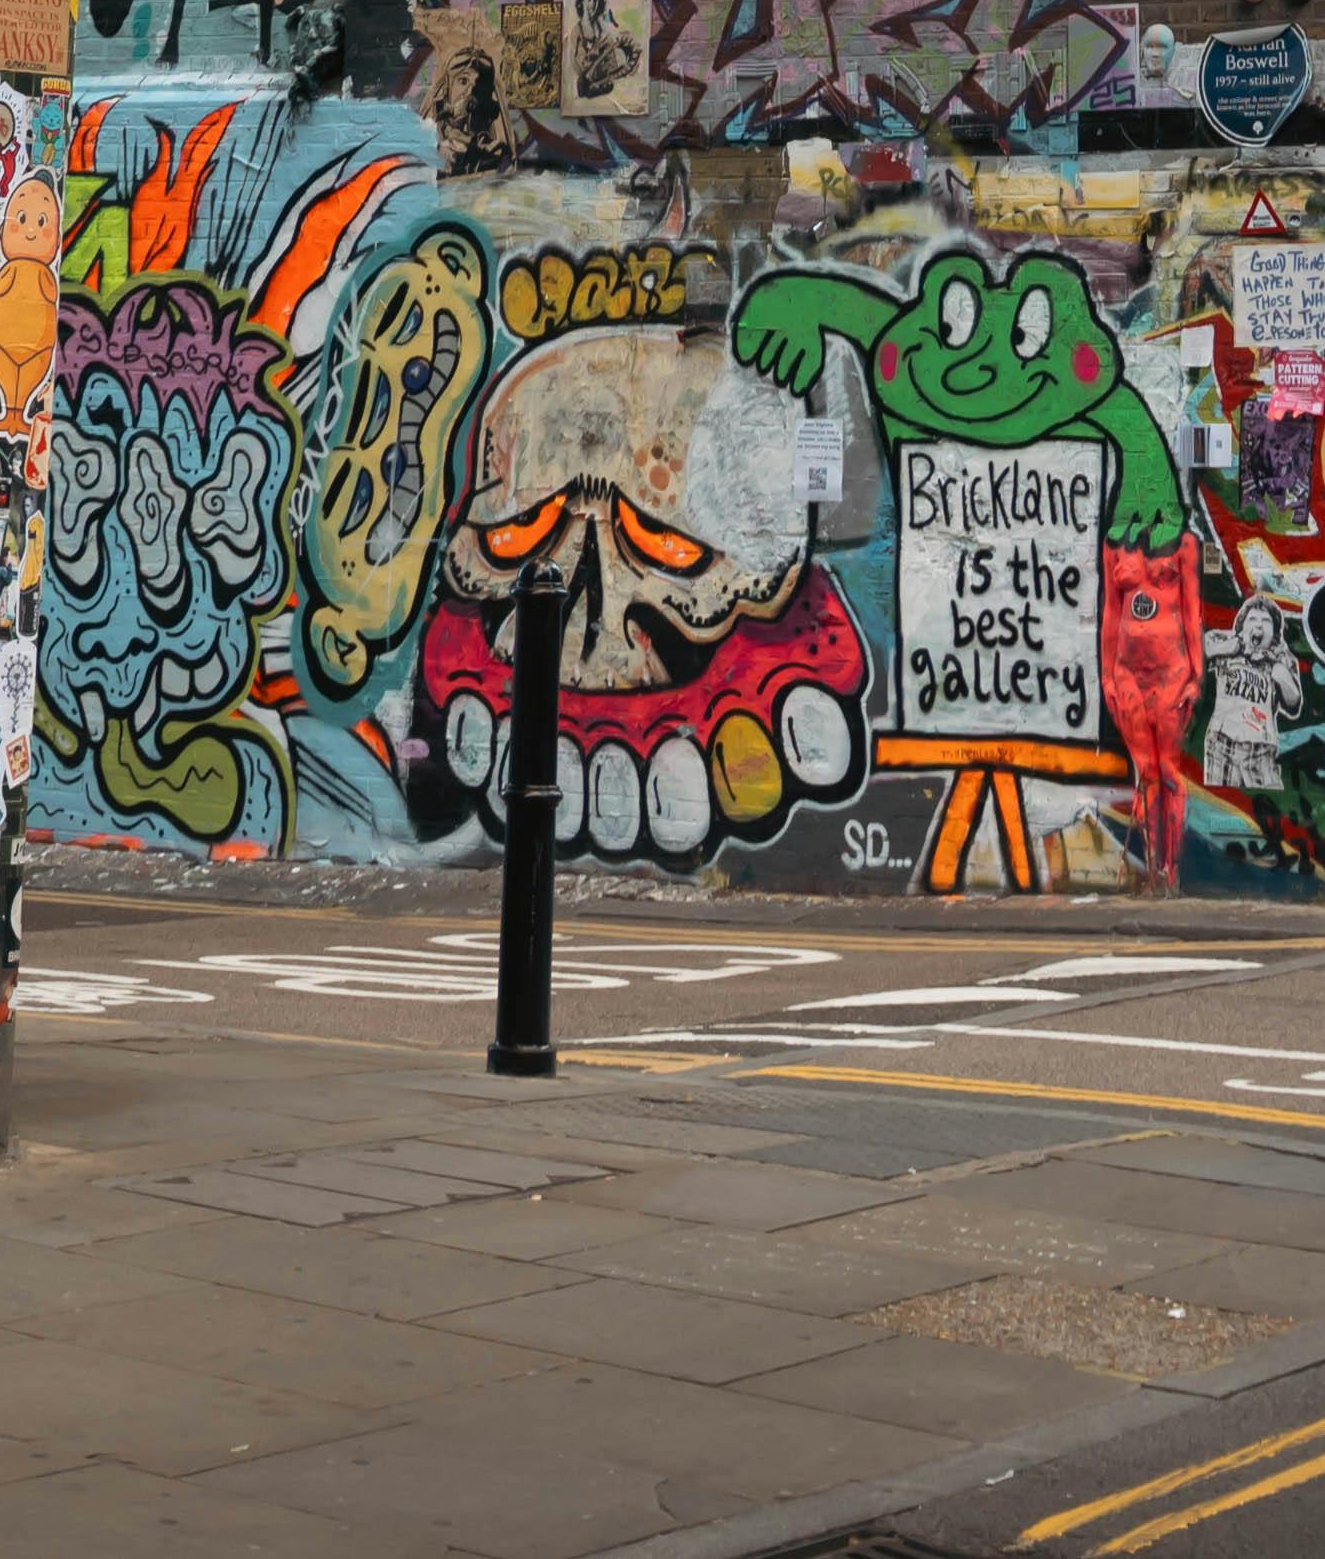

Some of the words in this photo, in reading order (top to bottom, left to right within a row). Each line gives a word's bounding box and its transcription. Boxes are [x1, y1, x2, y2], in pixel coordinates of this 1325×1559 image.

[504, 3, 563, 17] EGGSHELL
[1226, 52, 1289, 71] Boswell
[1249, 74, 1270, 86] still
[1273, 74, 1296, 85] alive
[1242, 273, 1294, 293] HAPPEN
[1248, 293, 1292, 312] THOSE
[1247, 309, 1292, 327] STAY
[1278, 363, 1323, 374] PATTERN
[1278, 374, 1319, 385] CUTTING
[1006, 537, 1081, 608] the
[951, 599, 1044, 651] best
[910, 647, 1088, 729] gallery
[1225, 679, 1268, 703] SATAN
